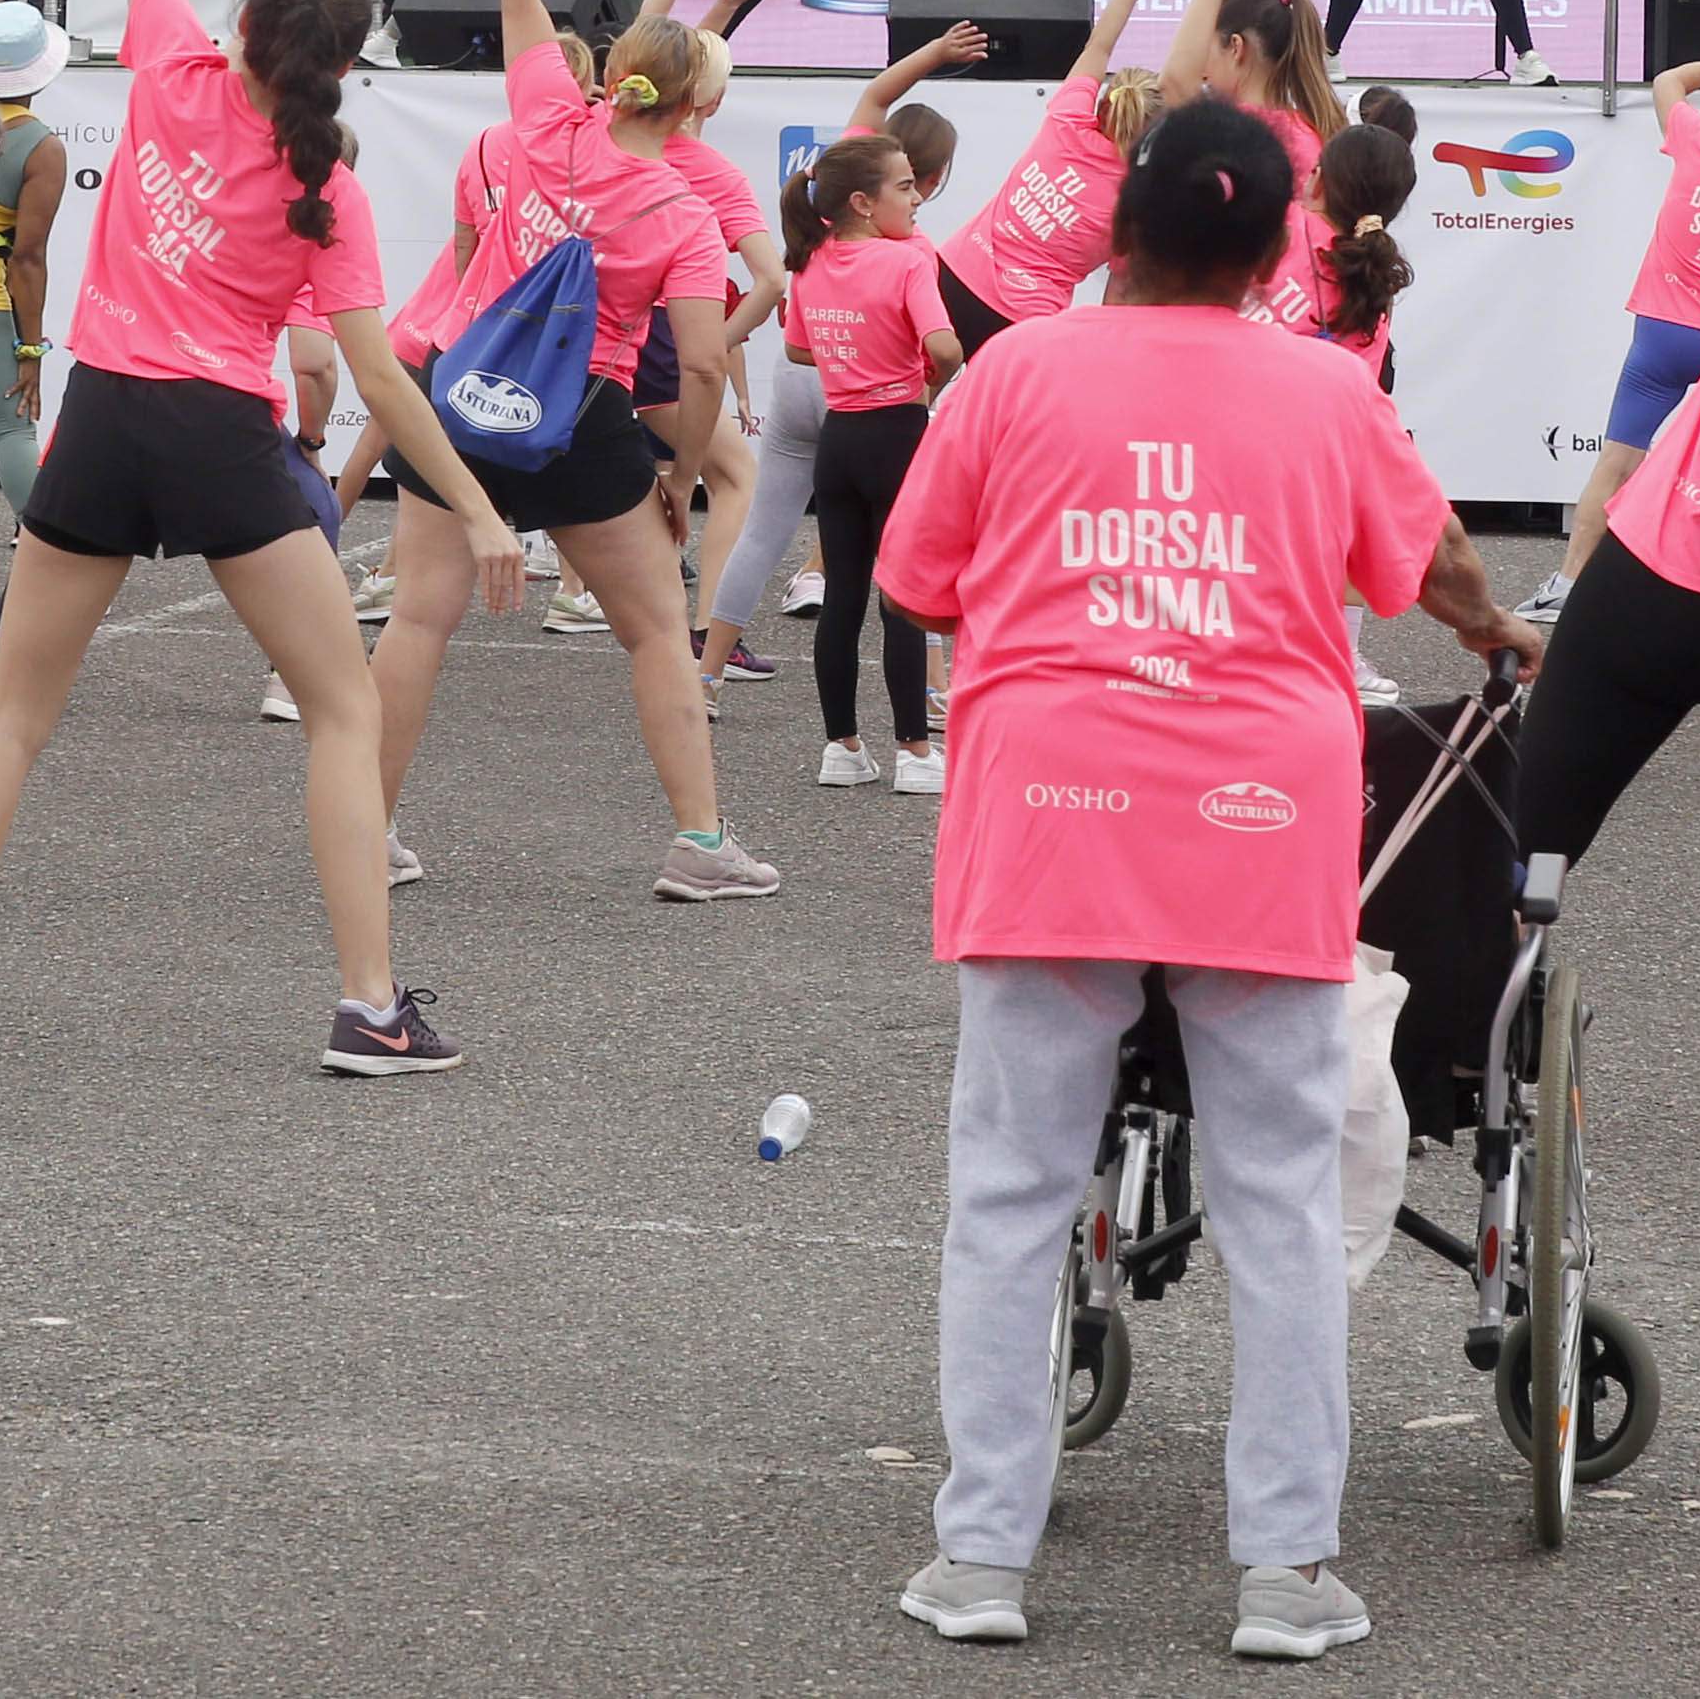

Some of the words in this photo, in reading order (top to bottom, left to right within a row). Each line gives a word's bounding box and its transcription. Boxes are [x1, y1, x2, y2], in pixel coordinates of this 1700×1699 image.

[178, 149, 225, 201] TU
[1021, 160, 1081, 233] DORSAL
[1054, 165, 1087, 197] TU
[1009, 186, 1057, 242] SUMA
[1431, 212, 1574, 235] TotalEnergies
[86, 284, 138, 325] OYSHO
[805, 307, 866, 325] CARRERA
[1269, 276, 1311, 324] TU
[813, 327, 830, 340] DE
[834, 328, 852, 342] LA
[1127, 441, 1195, 502] TU
[1061, 508, 1258, 575] DORSAL
[1087, 574, 1236, 639] SUMA
[1024, 783, 1131, 814] OYSHO
[1206, 797, 1291, 824] ASTURIANA
